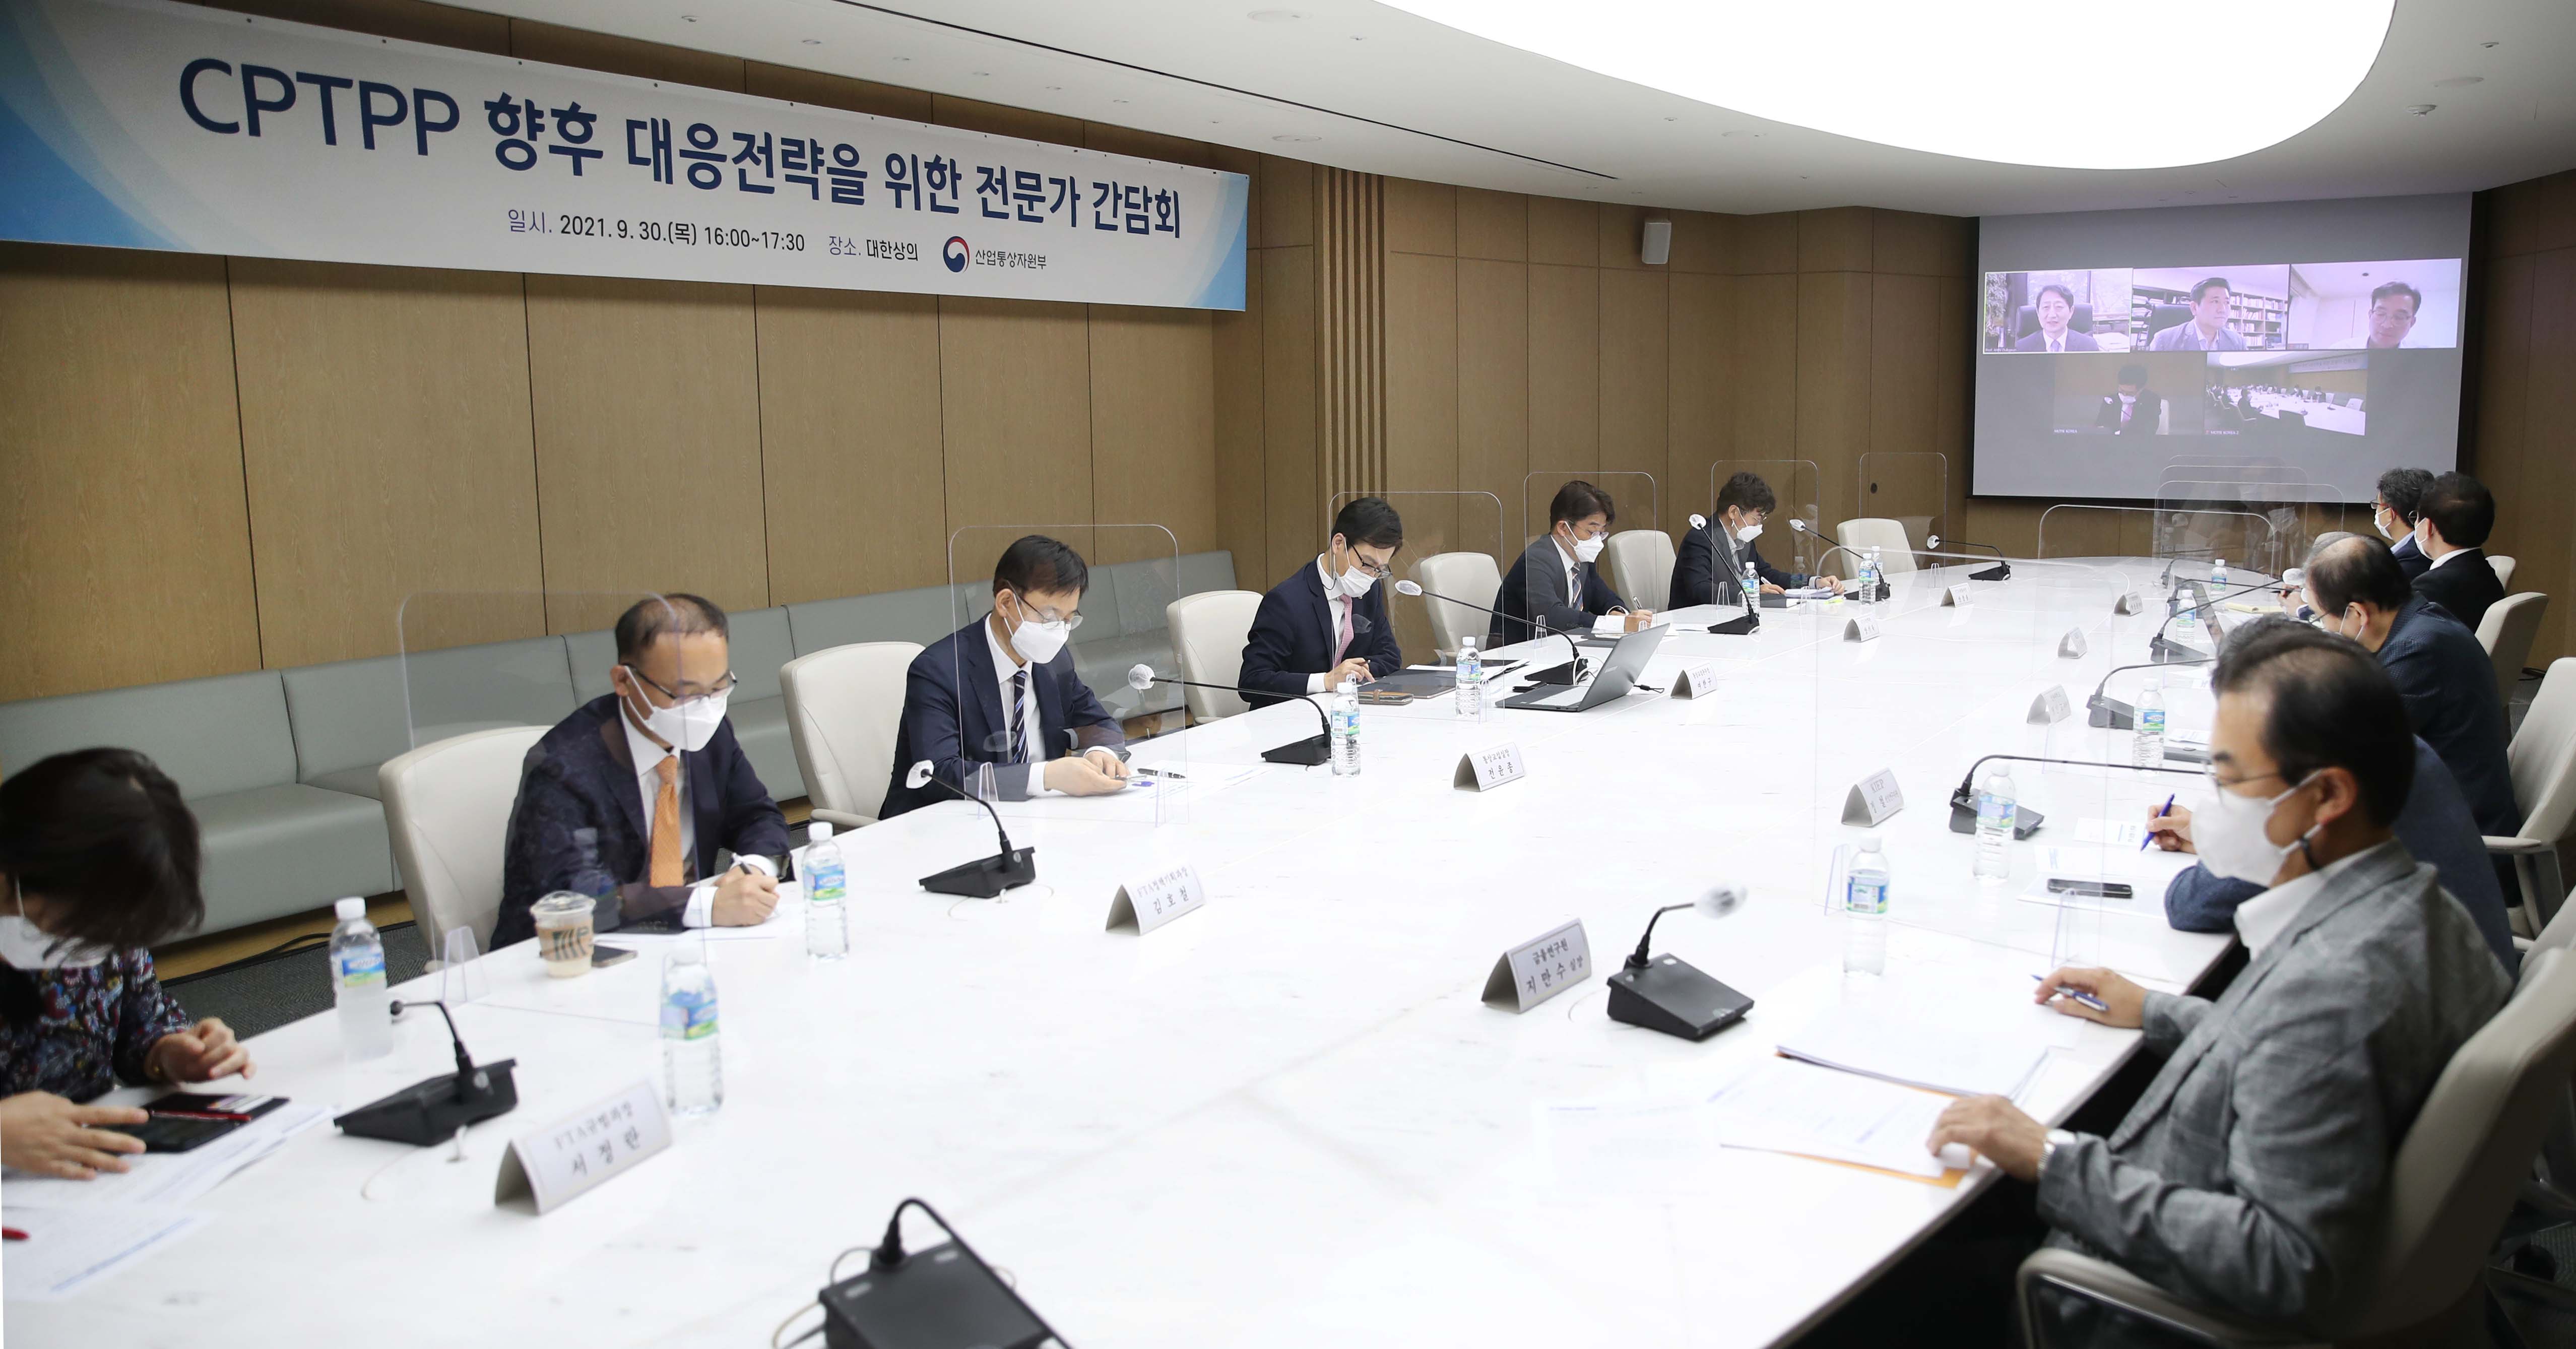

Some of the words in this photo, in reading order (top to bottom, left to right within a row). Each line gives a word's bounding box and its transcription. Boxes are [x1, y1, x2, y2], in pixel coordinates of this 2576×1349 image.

[179, 56, 460, 156] CPTPP
[484, 92, 603, 176] 향후
[626, 117, 867, 206] 대응전략을
[885, 153, 962, 214] 위한
[976, 165, 1080, 227] 전문가
[1092, 181, 1180, 238] 간담회
[508, 210, 552, 234] 일시.
[704, 227, 804, 251] 16:00~17:30
[829, 236, 861, 256] 장소.
[866, 239, 918, 261] 대한상의
[976, 250, 1047, 270] 산업통상자원부
[1488, 762, 1513, 780] 전윤종
[1526, 962, 1566, 994] 지만수
